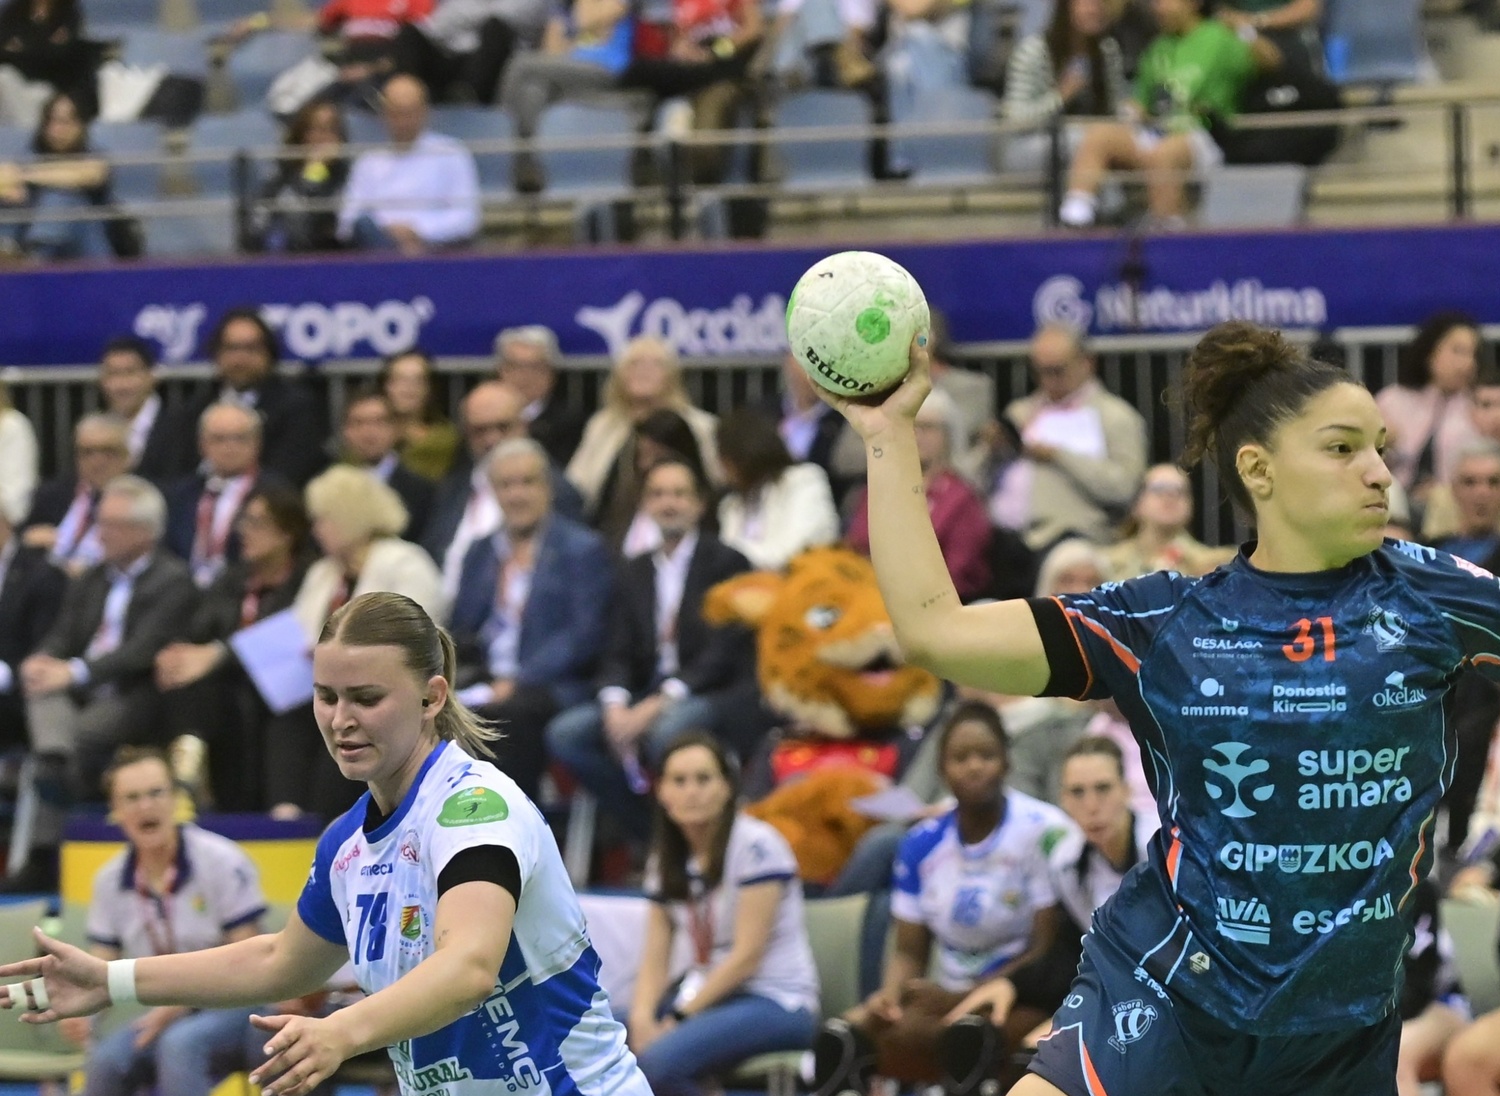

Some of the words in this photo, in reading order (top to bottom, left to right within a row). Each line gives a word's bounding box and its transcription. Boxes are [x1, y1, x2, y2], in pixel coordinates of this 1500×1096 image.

[1282, 616, 1336, 662] 31
[1273, 683, 1346, 698] Donostia
[1181, 705, 1249, 717] ammma
[1298, 746, 1410, 781] super
[1298, 776, 1412, 810] amara
[1219, 836, 1394, 874] GIPUZKOA
[354, 892, 388, 965] 78
